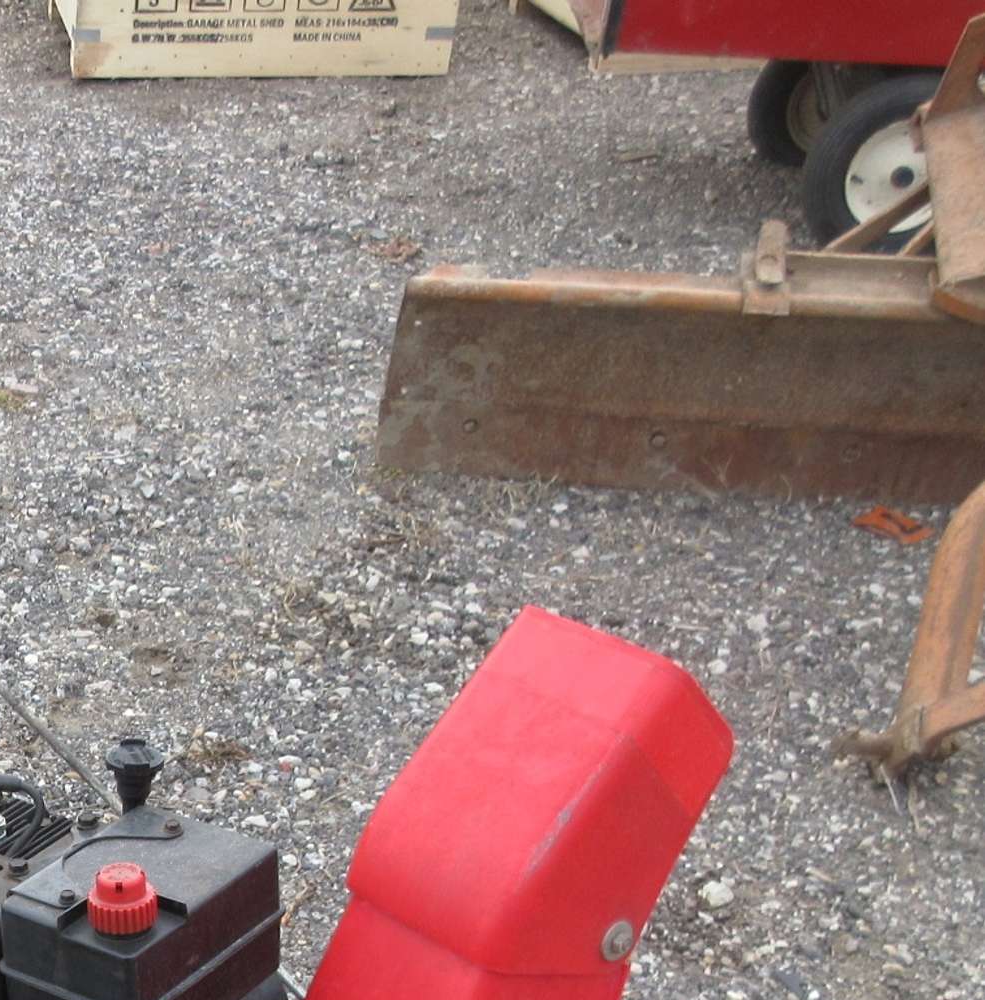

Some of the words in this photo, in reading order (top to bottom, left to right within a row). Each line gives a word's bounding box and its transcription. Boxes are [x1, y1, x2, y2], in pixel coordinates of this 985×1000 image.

[227, 18, 256, 28] METAL
[259, 18, 285, 28] SHED
[293, 32, 319, 42] MADE
[321, 32, 331, 42] IN
[333, 32, 362, 42] CHINA
